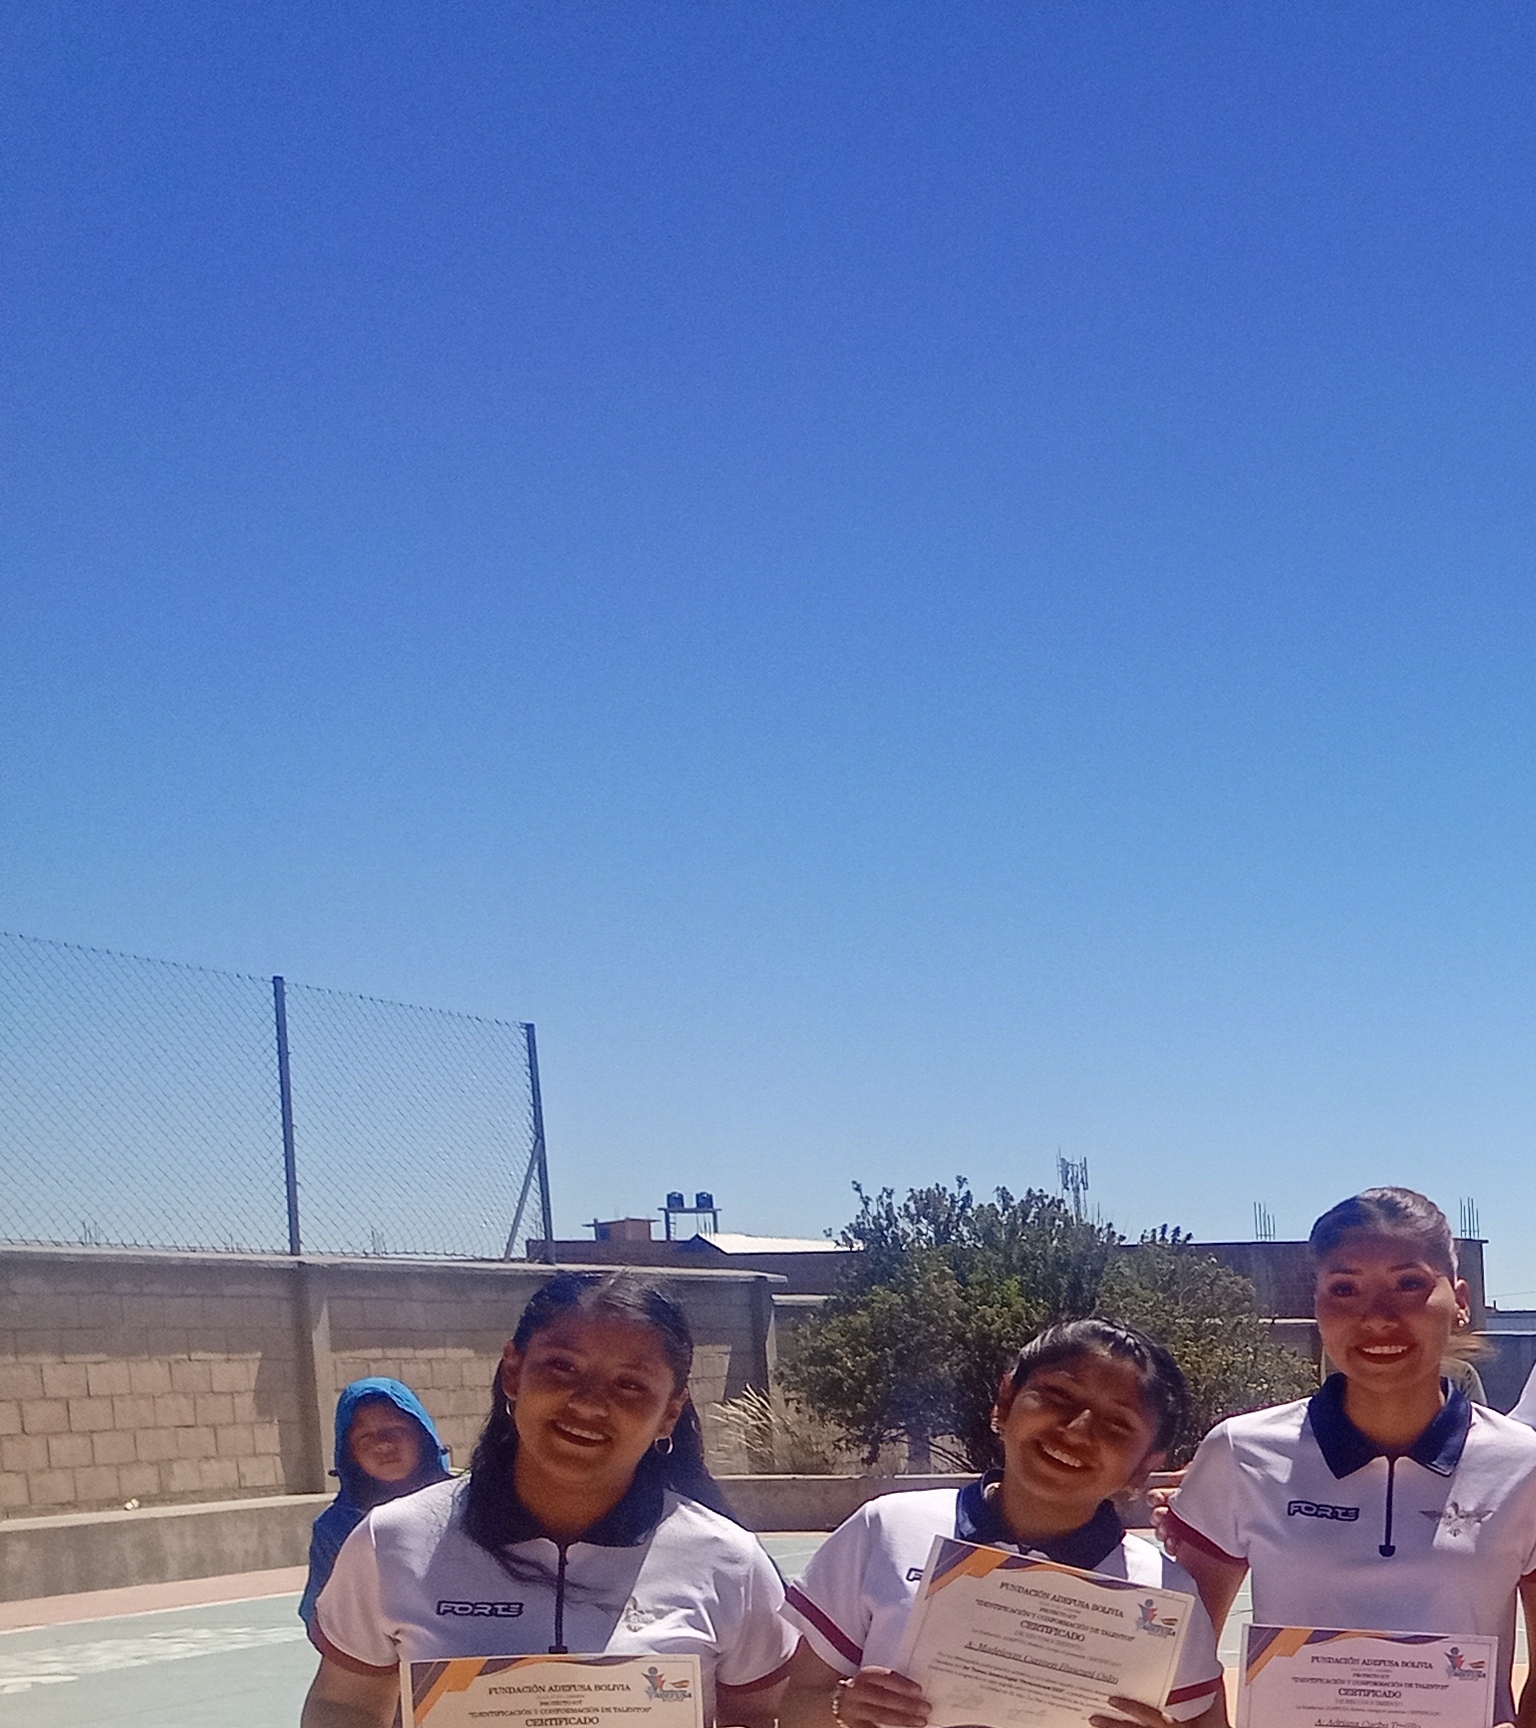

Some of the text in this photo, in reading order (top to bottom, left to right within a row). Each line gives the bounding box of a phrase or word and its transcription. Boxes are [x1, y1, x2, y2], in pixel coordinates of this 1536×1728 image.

[1290, 1502, 1358, 1520] FORTE
[438, 1602, 521, 1616] FORTE
[1020, 1618, 1087, 1641] CERTIFICADO
[1337, 1688, 1402, 1698] CERTIFICADO
[525, 1716, 599, 1726] CERTIFICADO
